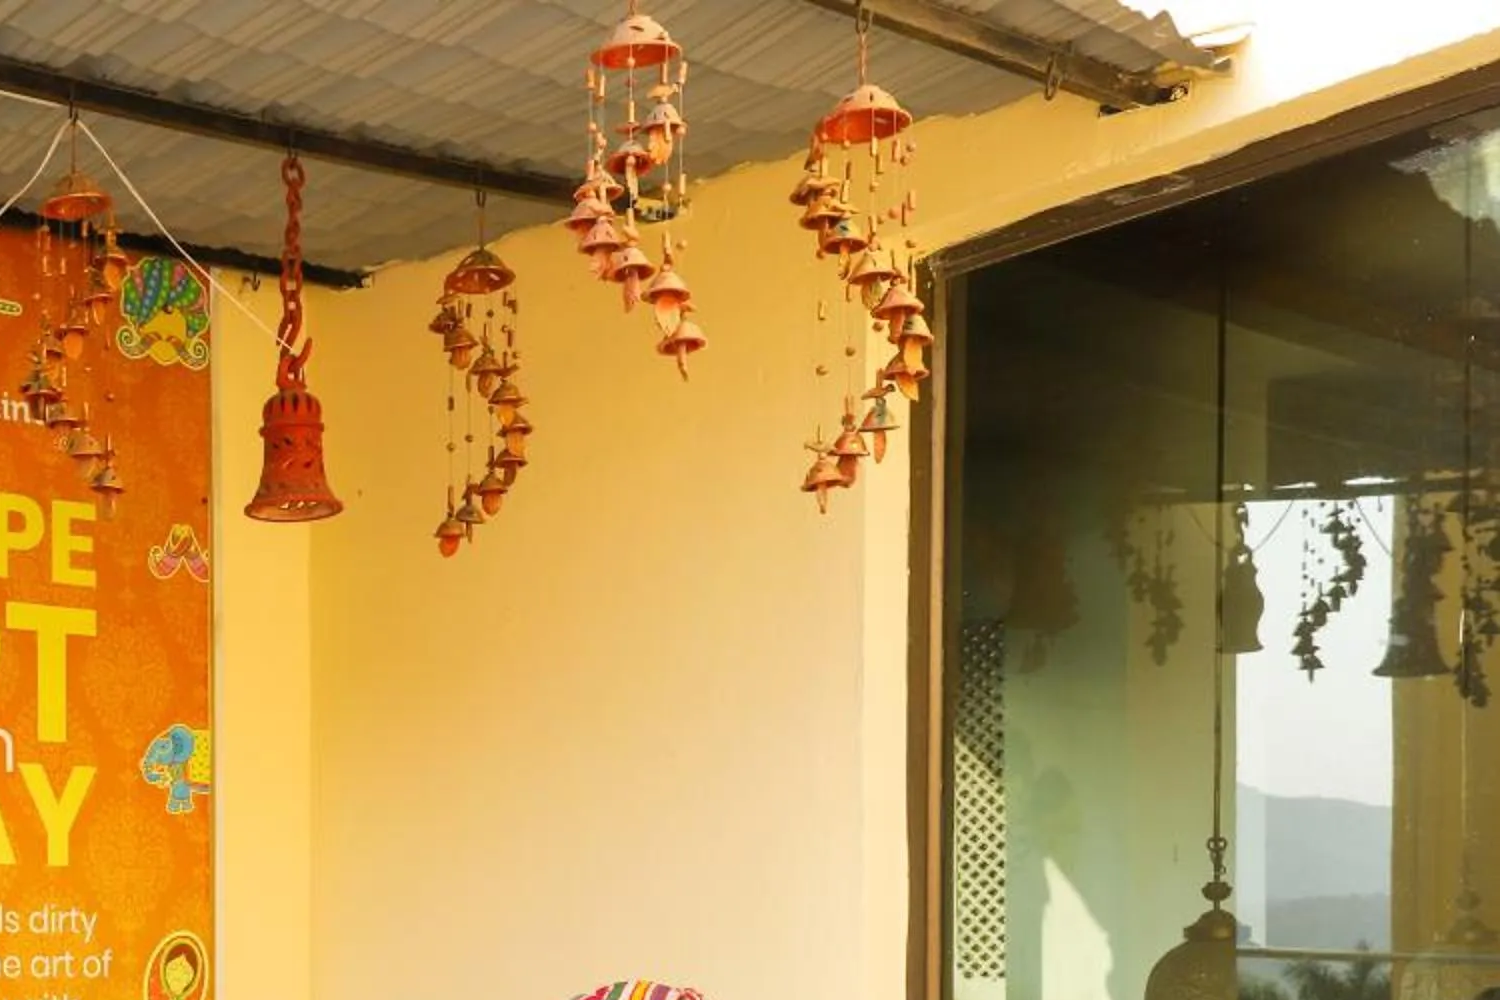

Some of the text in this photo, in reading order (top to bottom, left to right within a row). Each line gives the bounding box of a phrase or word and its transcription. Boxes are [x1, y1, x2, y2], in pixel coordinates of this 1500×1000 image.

[27, 902, 98, 944] dirty
[28, 951, 77, 980] art
[81, 946, 114, 980] of
